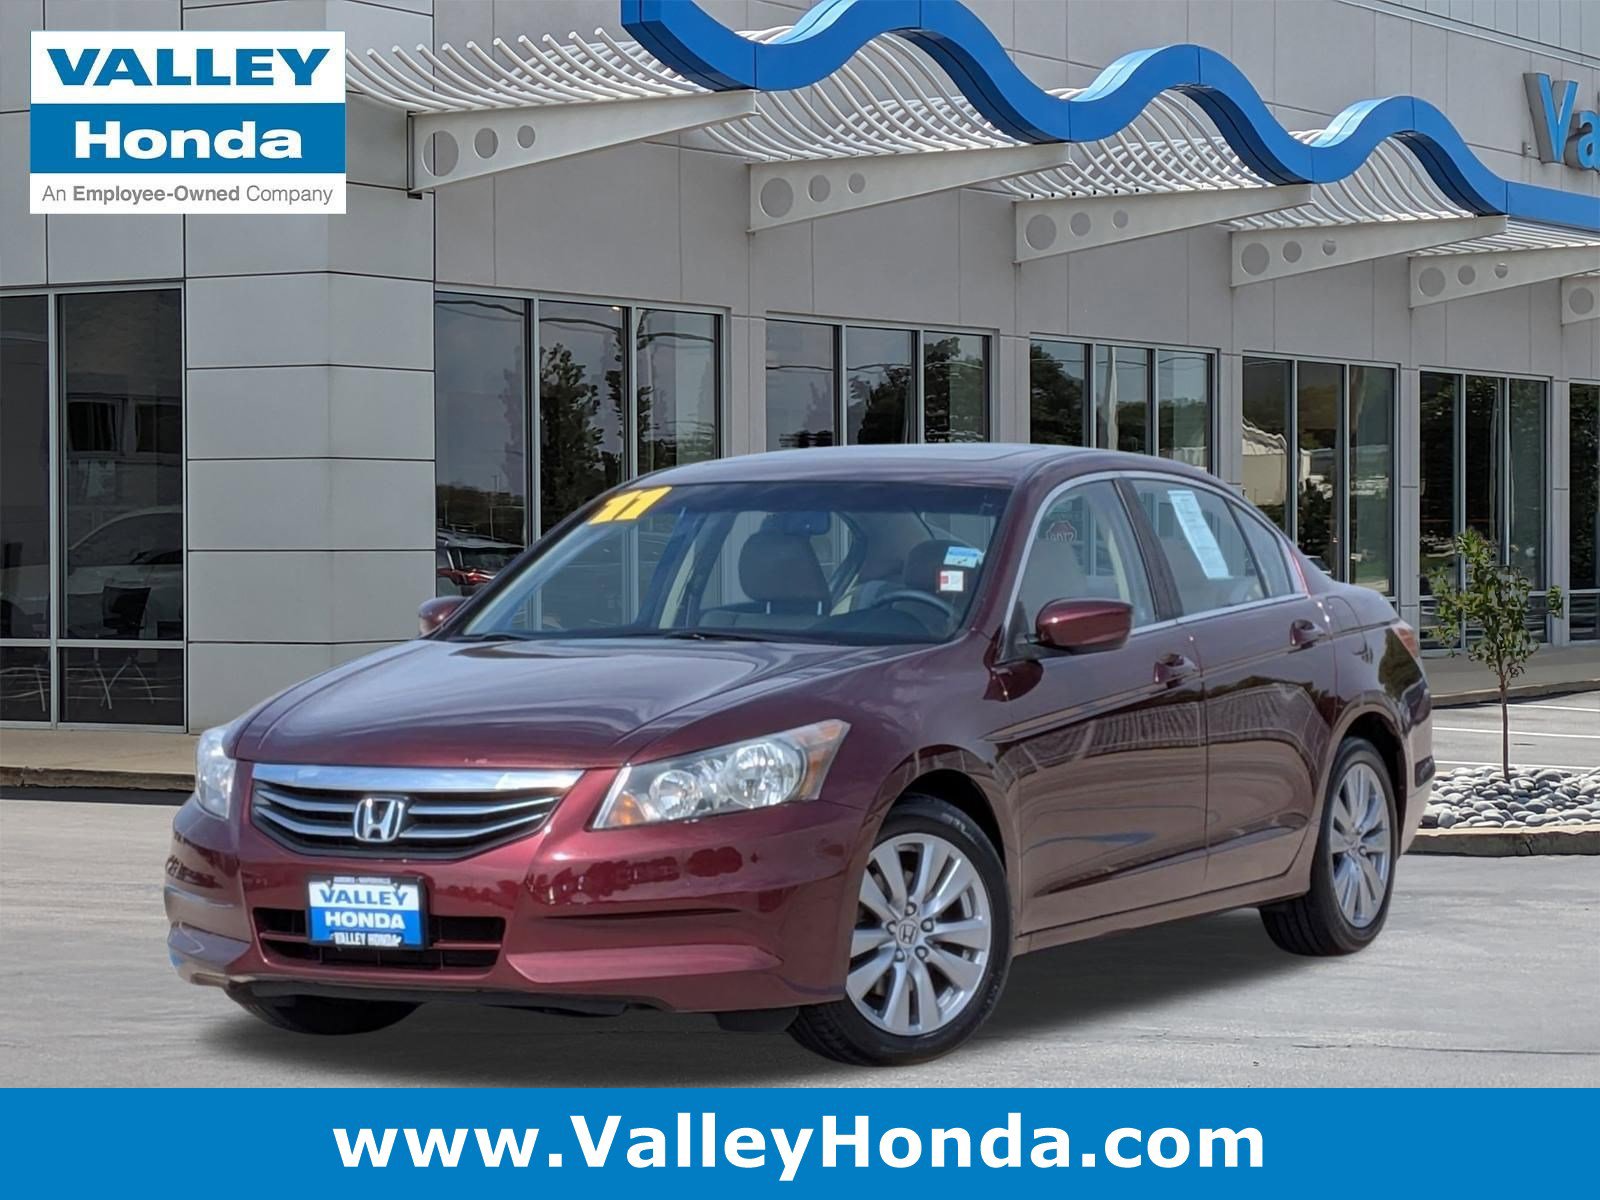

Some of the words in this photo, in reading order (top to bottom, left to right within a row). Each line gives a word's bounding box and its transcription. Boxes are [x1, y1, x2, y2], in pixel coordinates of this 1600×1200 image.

[1523, 72, 1600, 171] Va
[587, 486, 673, 525] 11
[319, 889, 408, 906] VALLEY
[324, 911, 406, 929] HONDA
